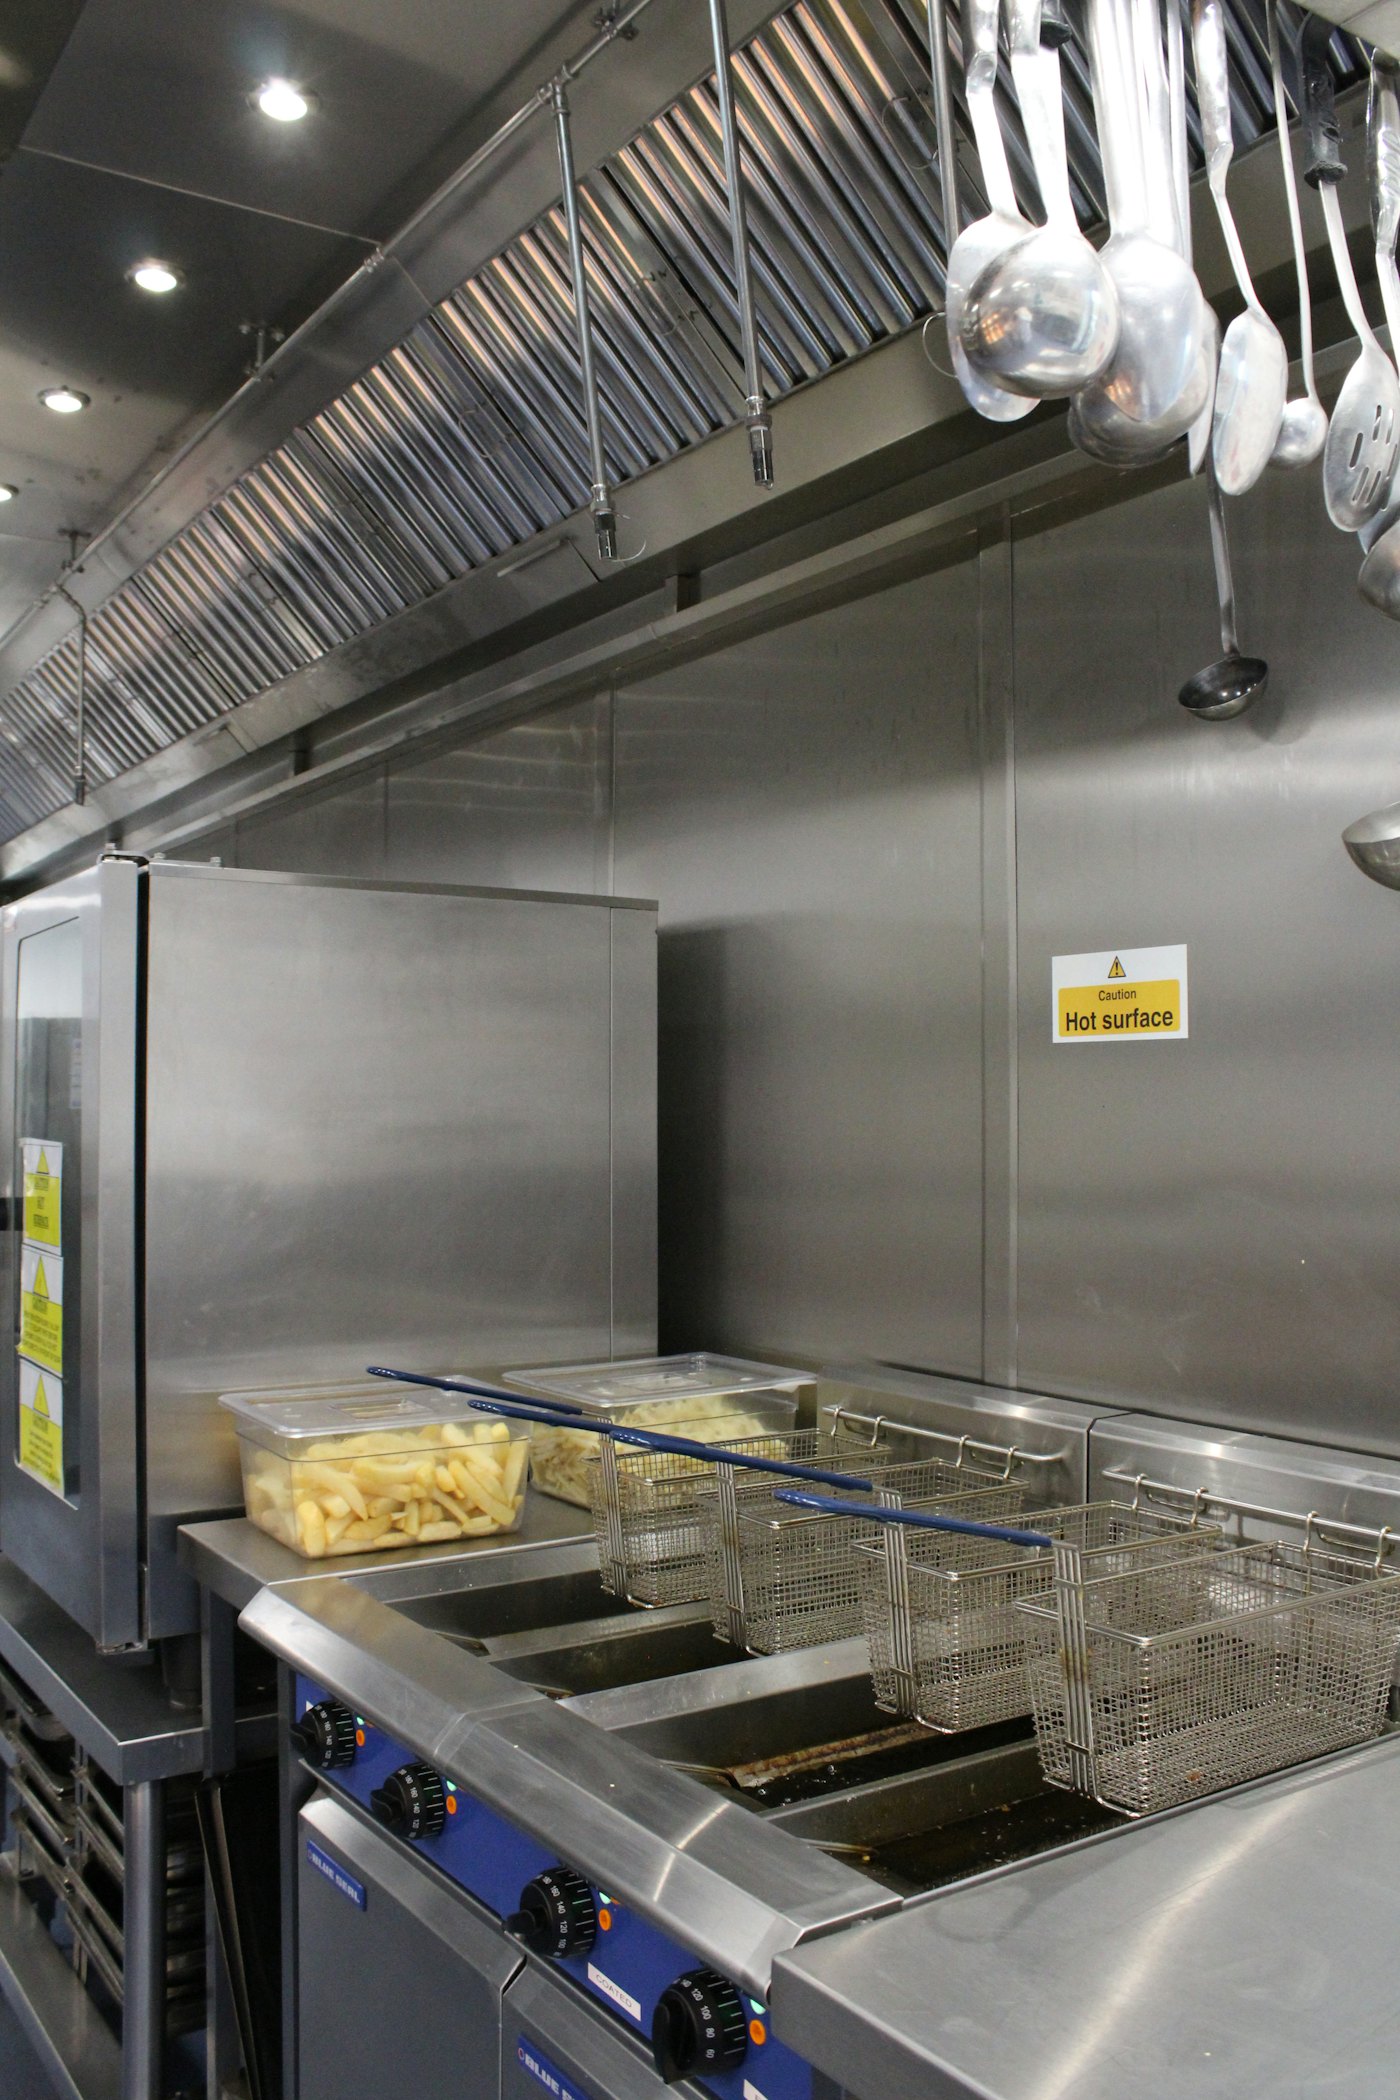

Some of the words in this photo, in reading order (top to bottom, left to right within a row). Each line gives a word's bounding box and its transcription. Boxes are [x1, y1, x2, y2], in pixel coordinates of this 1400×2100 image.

[1098, 988, 1137, 1001] Caution
[1066, 1011, 1097, 1031] Hot
[1102, 1007, 1174, 1030] surface
[556, 1900, 566, 1914] 140
[559, 1920, 568, 1934] 120
[558, 1938, 567, 1949] 100
[691, 1988, 704, 2002] 120
[700, 2005, 712, 2020] 100
[705, 2027, 716, 2038] 80
[705, 2048, 715, 2059] 60
[524, 2053, 560, 2095] BLUE
